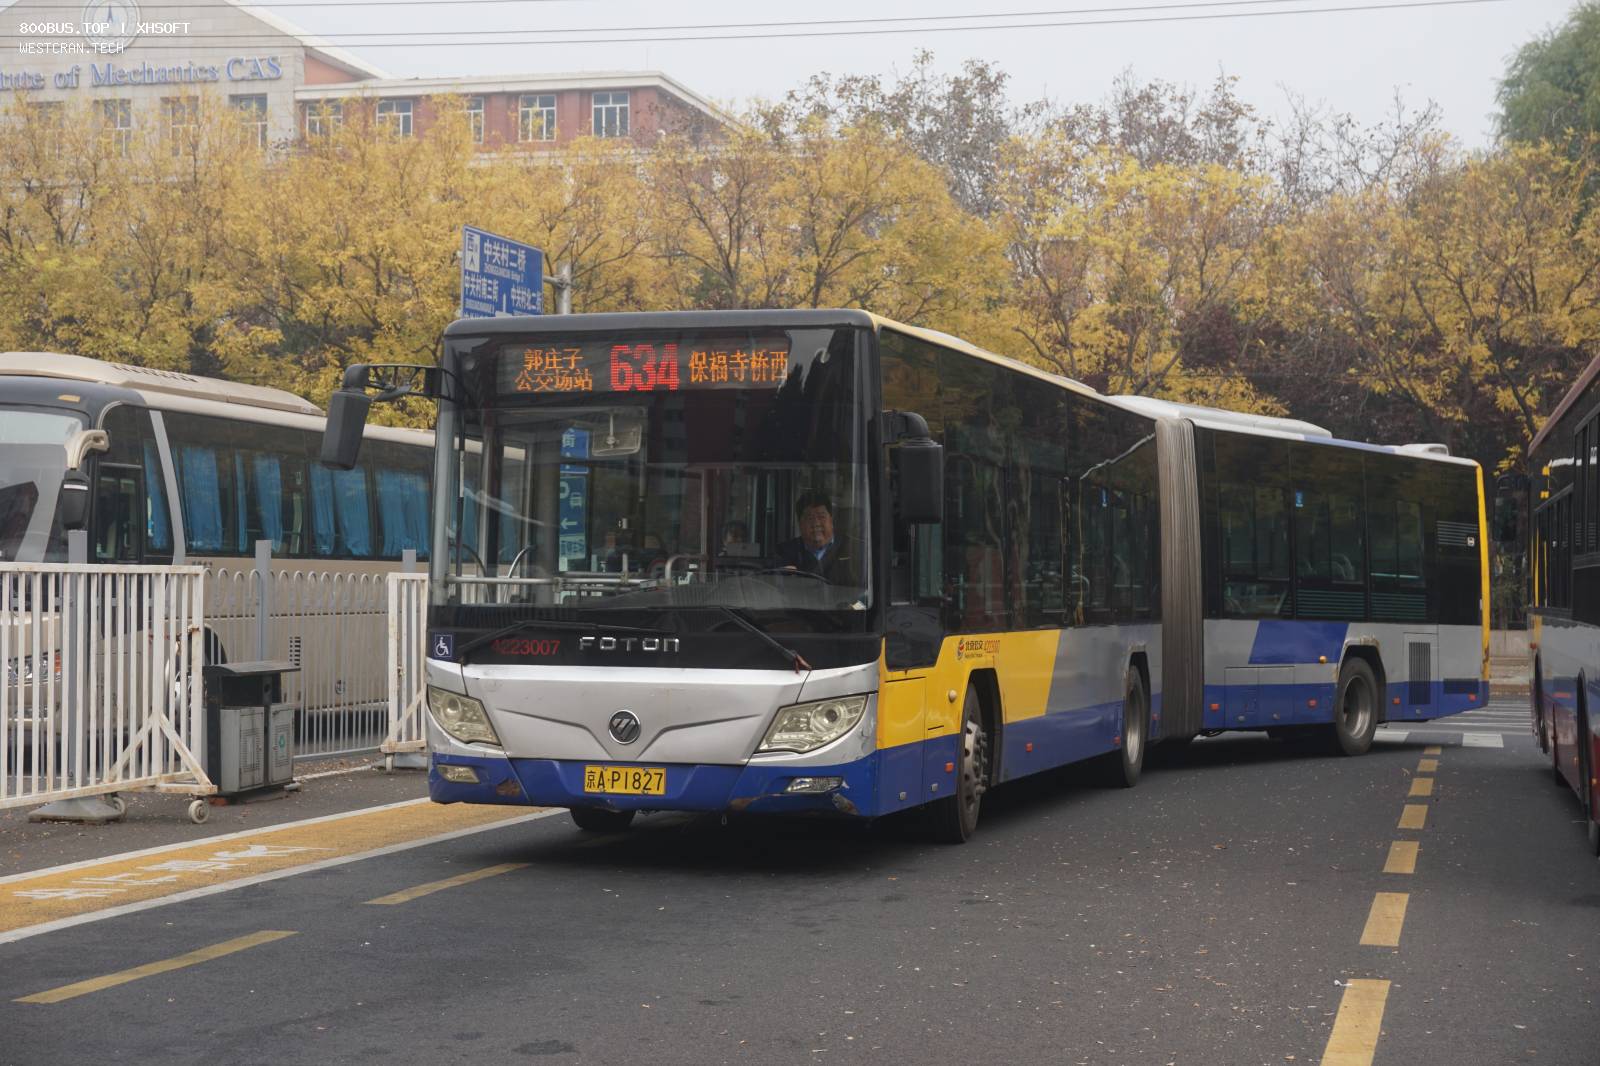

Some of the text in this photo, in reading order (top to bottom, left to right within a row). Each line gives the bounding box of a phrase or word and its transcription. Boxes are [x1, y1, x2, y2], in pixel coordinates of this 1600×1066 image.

[54, 65, 81, 89] of
[90, 60, 219, 87] Mechanics
[225, 55, 283, 81] CAS
[523, 348, 584, 371] 郭庄子
[610, 343, 680, 391] 634
[688, 350, 789, 383] 保福寺桥西
[515, 370, 593, 392] 公交场站
[579, 636, 680, 652] FOTON
